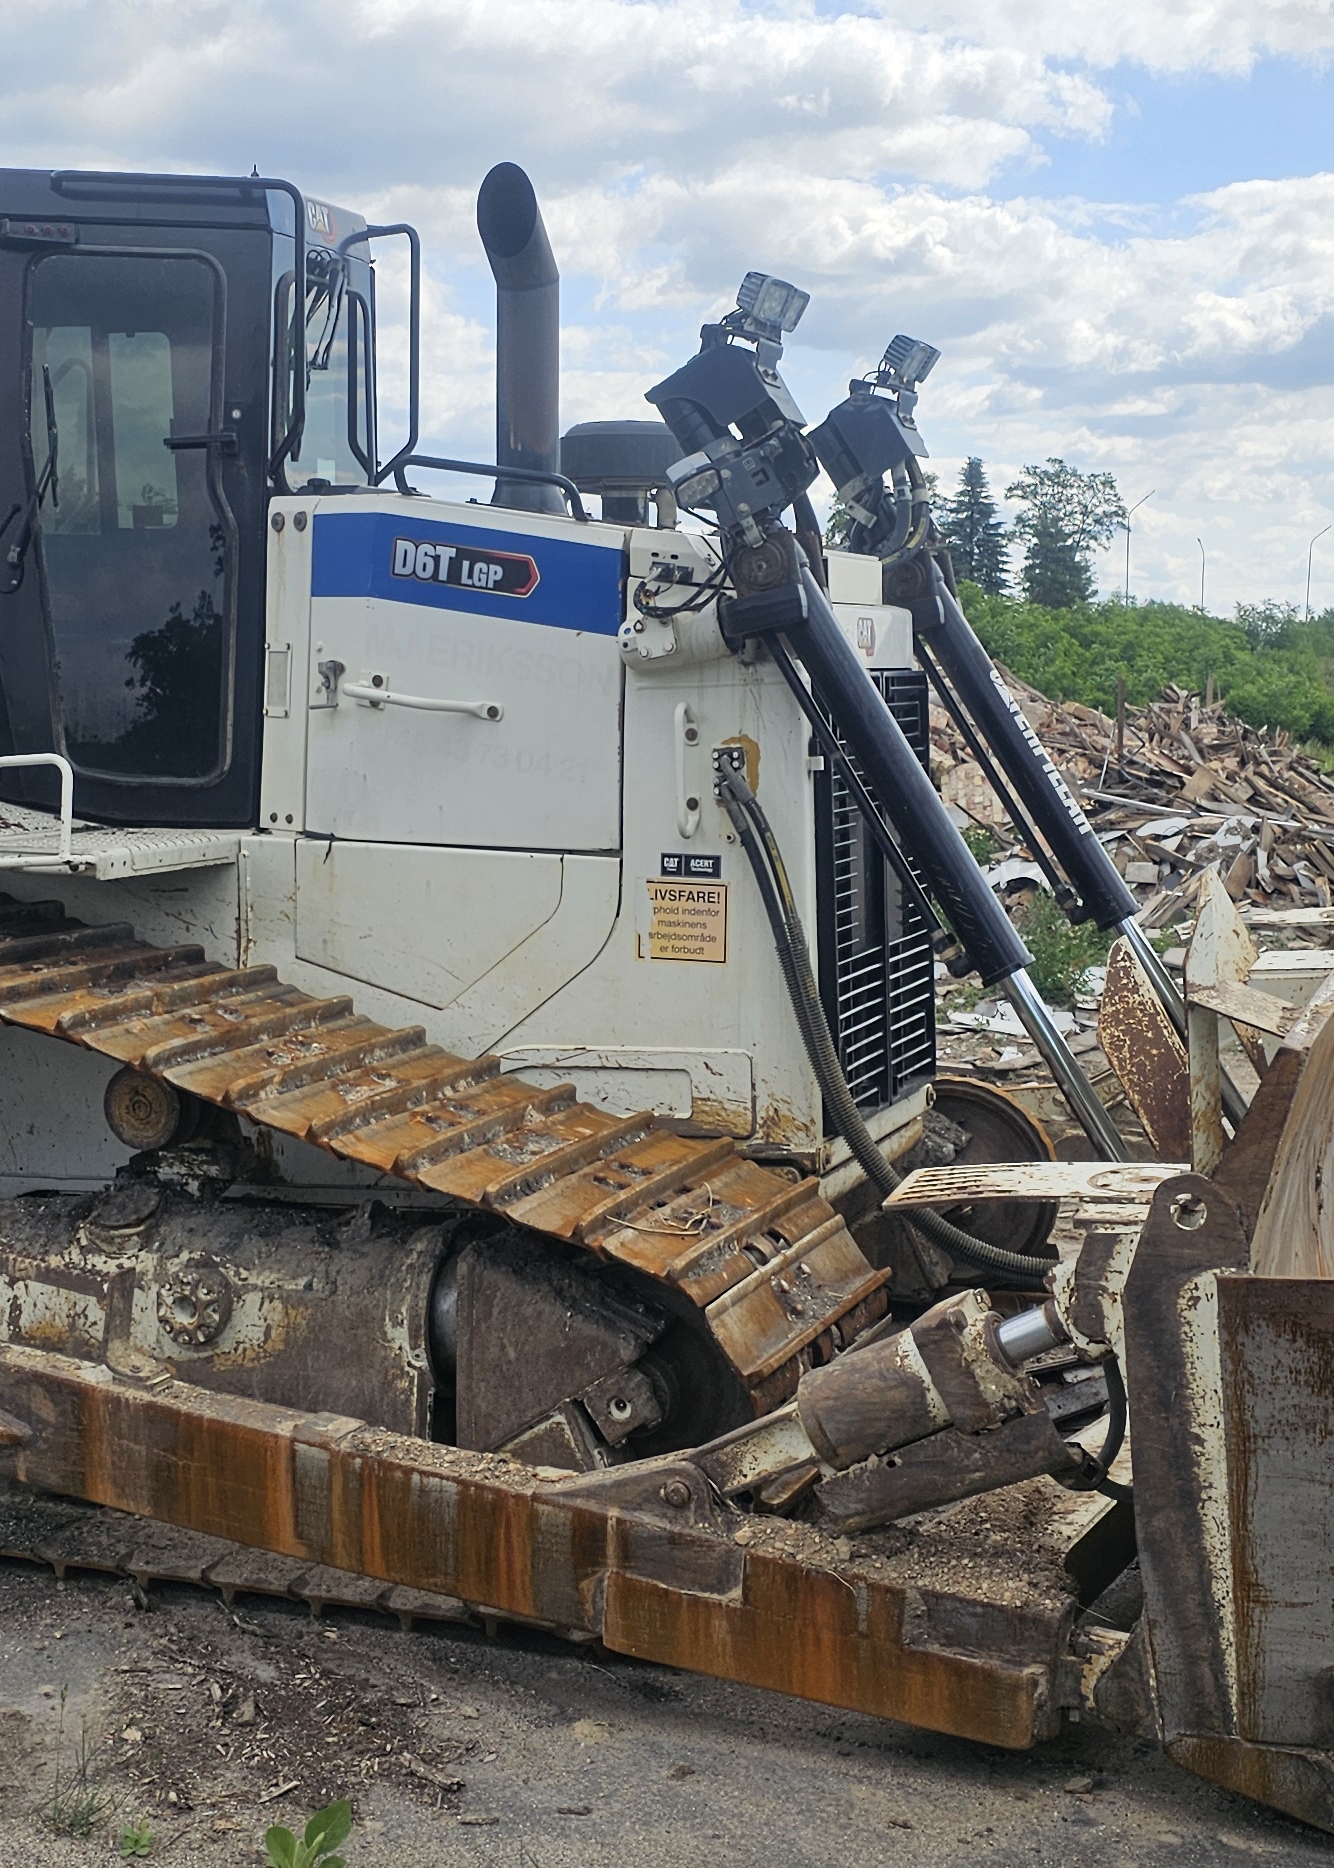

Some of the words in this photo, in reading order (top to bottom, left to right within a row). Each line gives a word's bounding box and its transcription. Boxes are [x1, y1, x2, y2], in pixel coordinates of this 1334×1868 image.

[307, 201, 330, 234] CAT
[394, 539, 457, 581] D6T
[460, 560, 504, 588] LGP
[857, 618, 872, 648] CAT
[664, 857, 679, 867] CAT
[690, 859, 714, 868] ACERT
[653, 906, 680, 916] phold
[681, 906, 720, 918] indenfor
[657, 919, 708, 930] maskinens
[648, 931, 717, 943] arbejdsområde
[659, 945, 669, 953] er
[671, 944, 705, 955] forbudt
